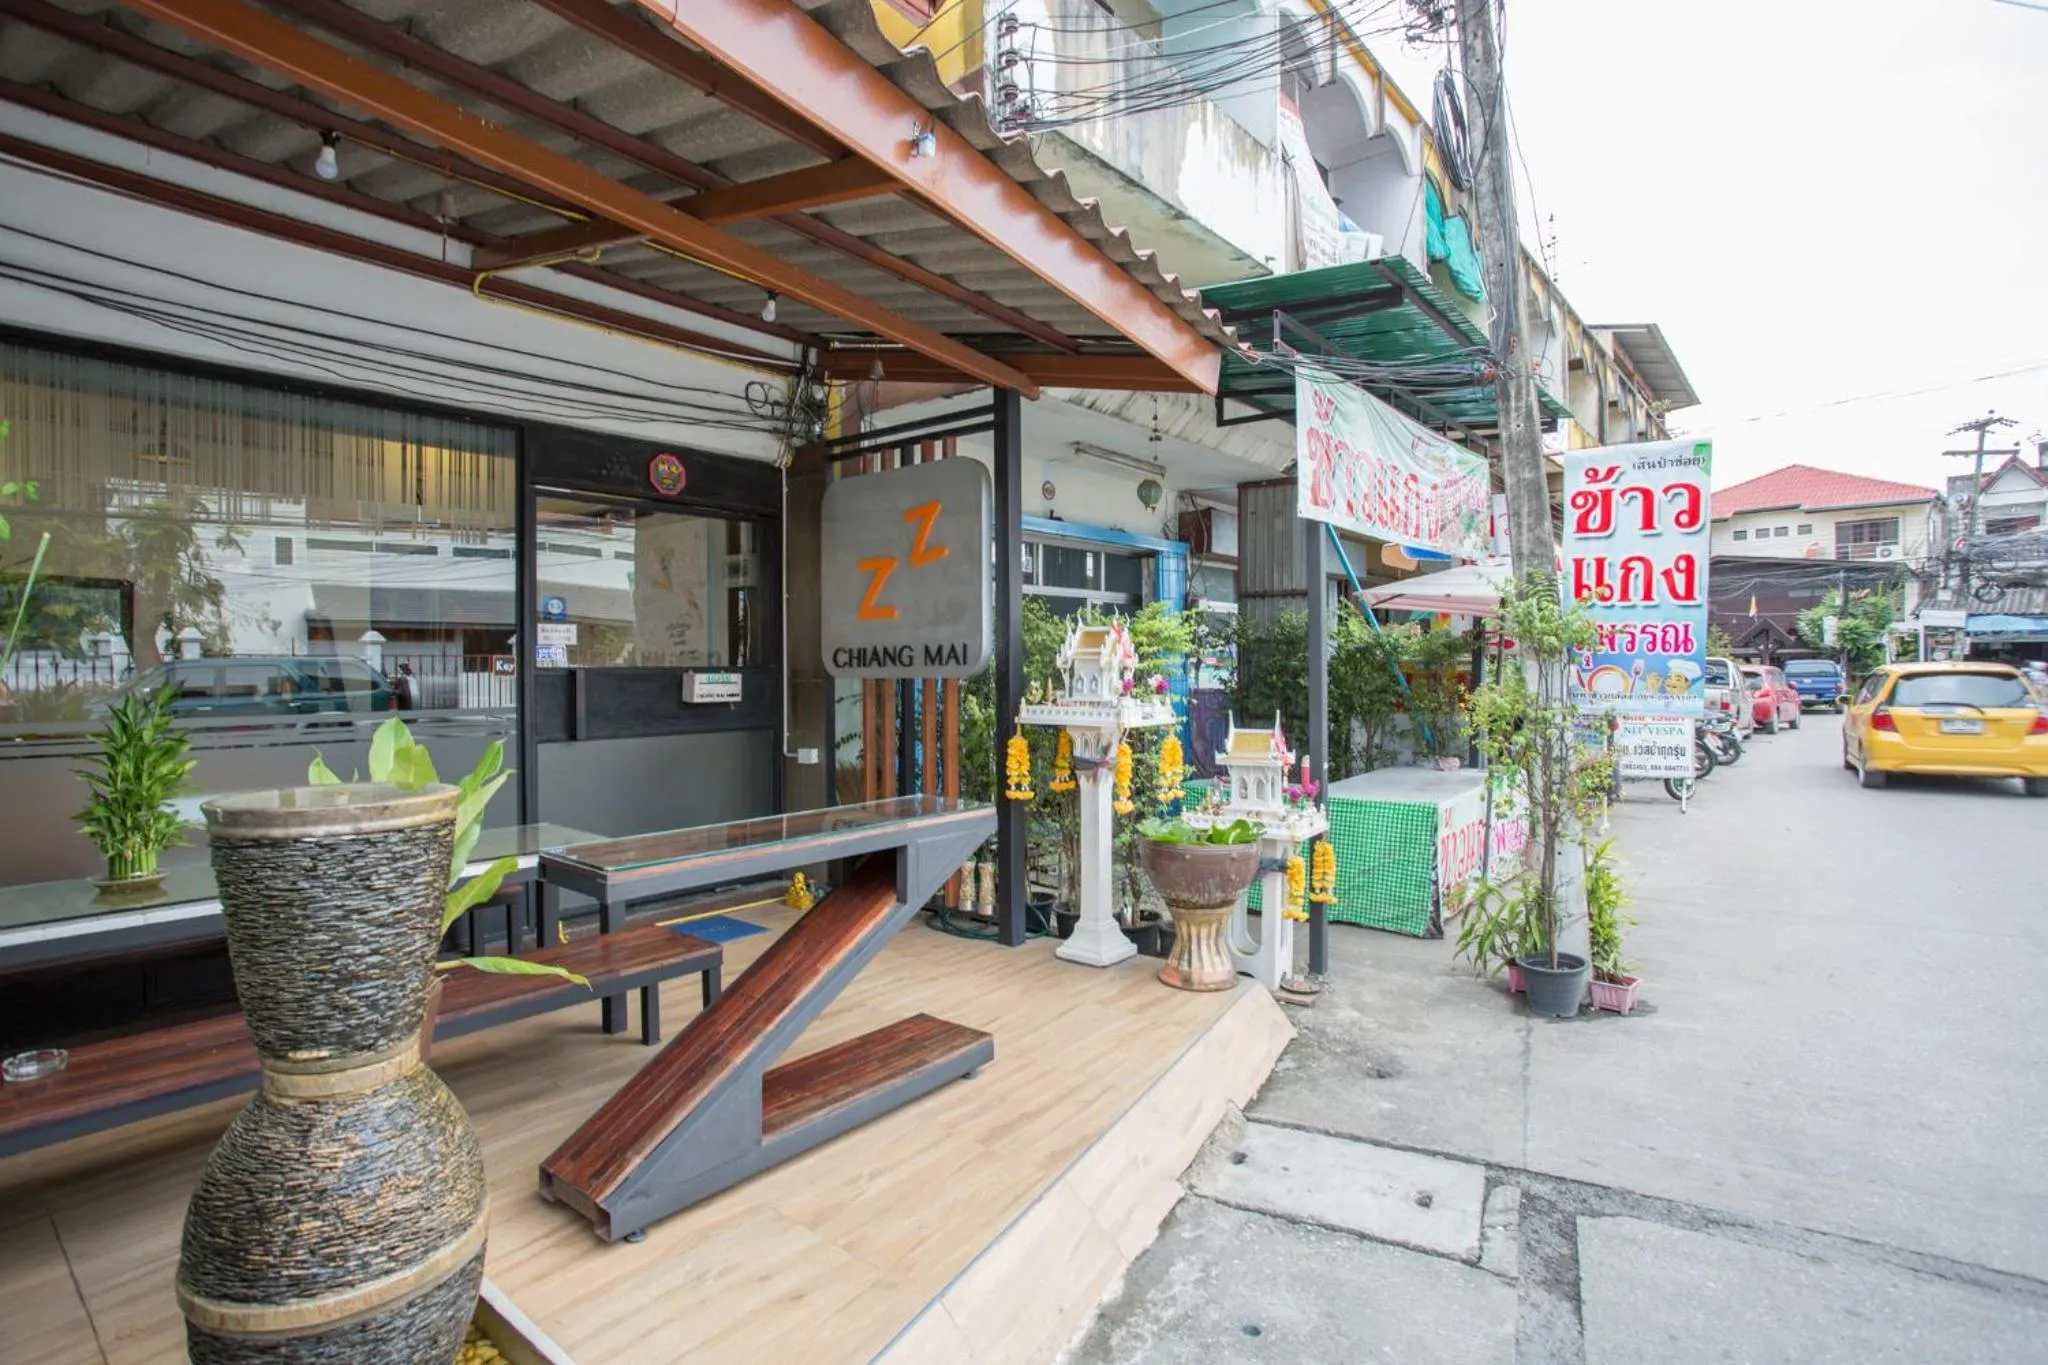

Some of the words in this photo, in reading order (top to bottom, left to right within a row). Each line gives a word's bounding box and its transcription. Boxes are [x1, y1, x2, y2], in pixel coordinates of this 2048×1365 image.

[1570, 464, 1704, 535] ข้าว
[1571, 553, 1698, 603] แกง
[832, 645, 914, 668] CHIANG
[924, 643, 968, 666] MAI
[1574, 622, 1695, 667] ุพรรณ
[1648, 725, 1685, 736] VESPA
